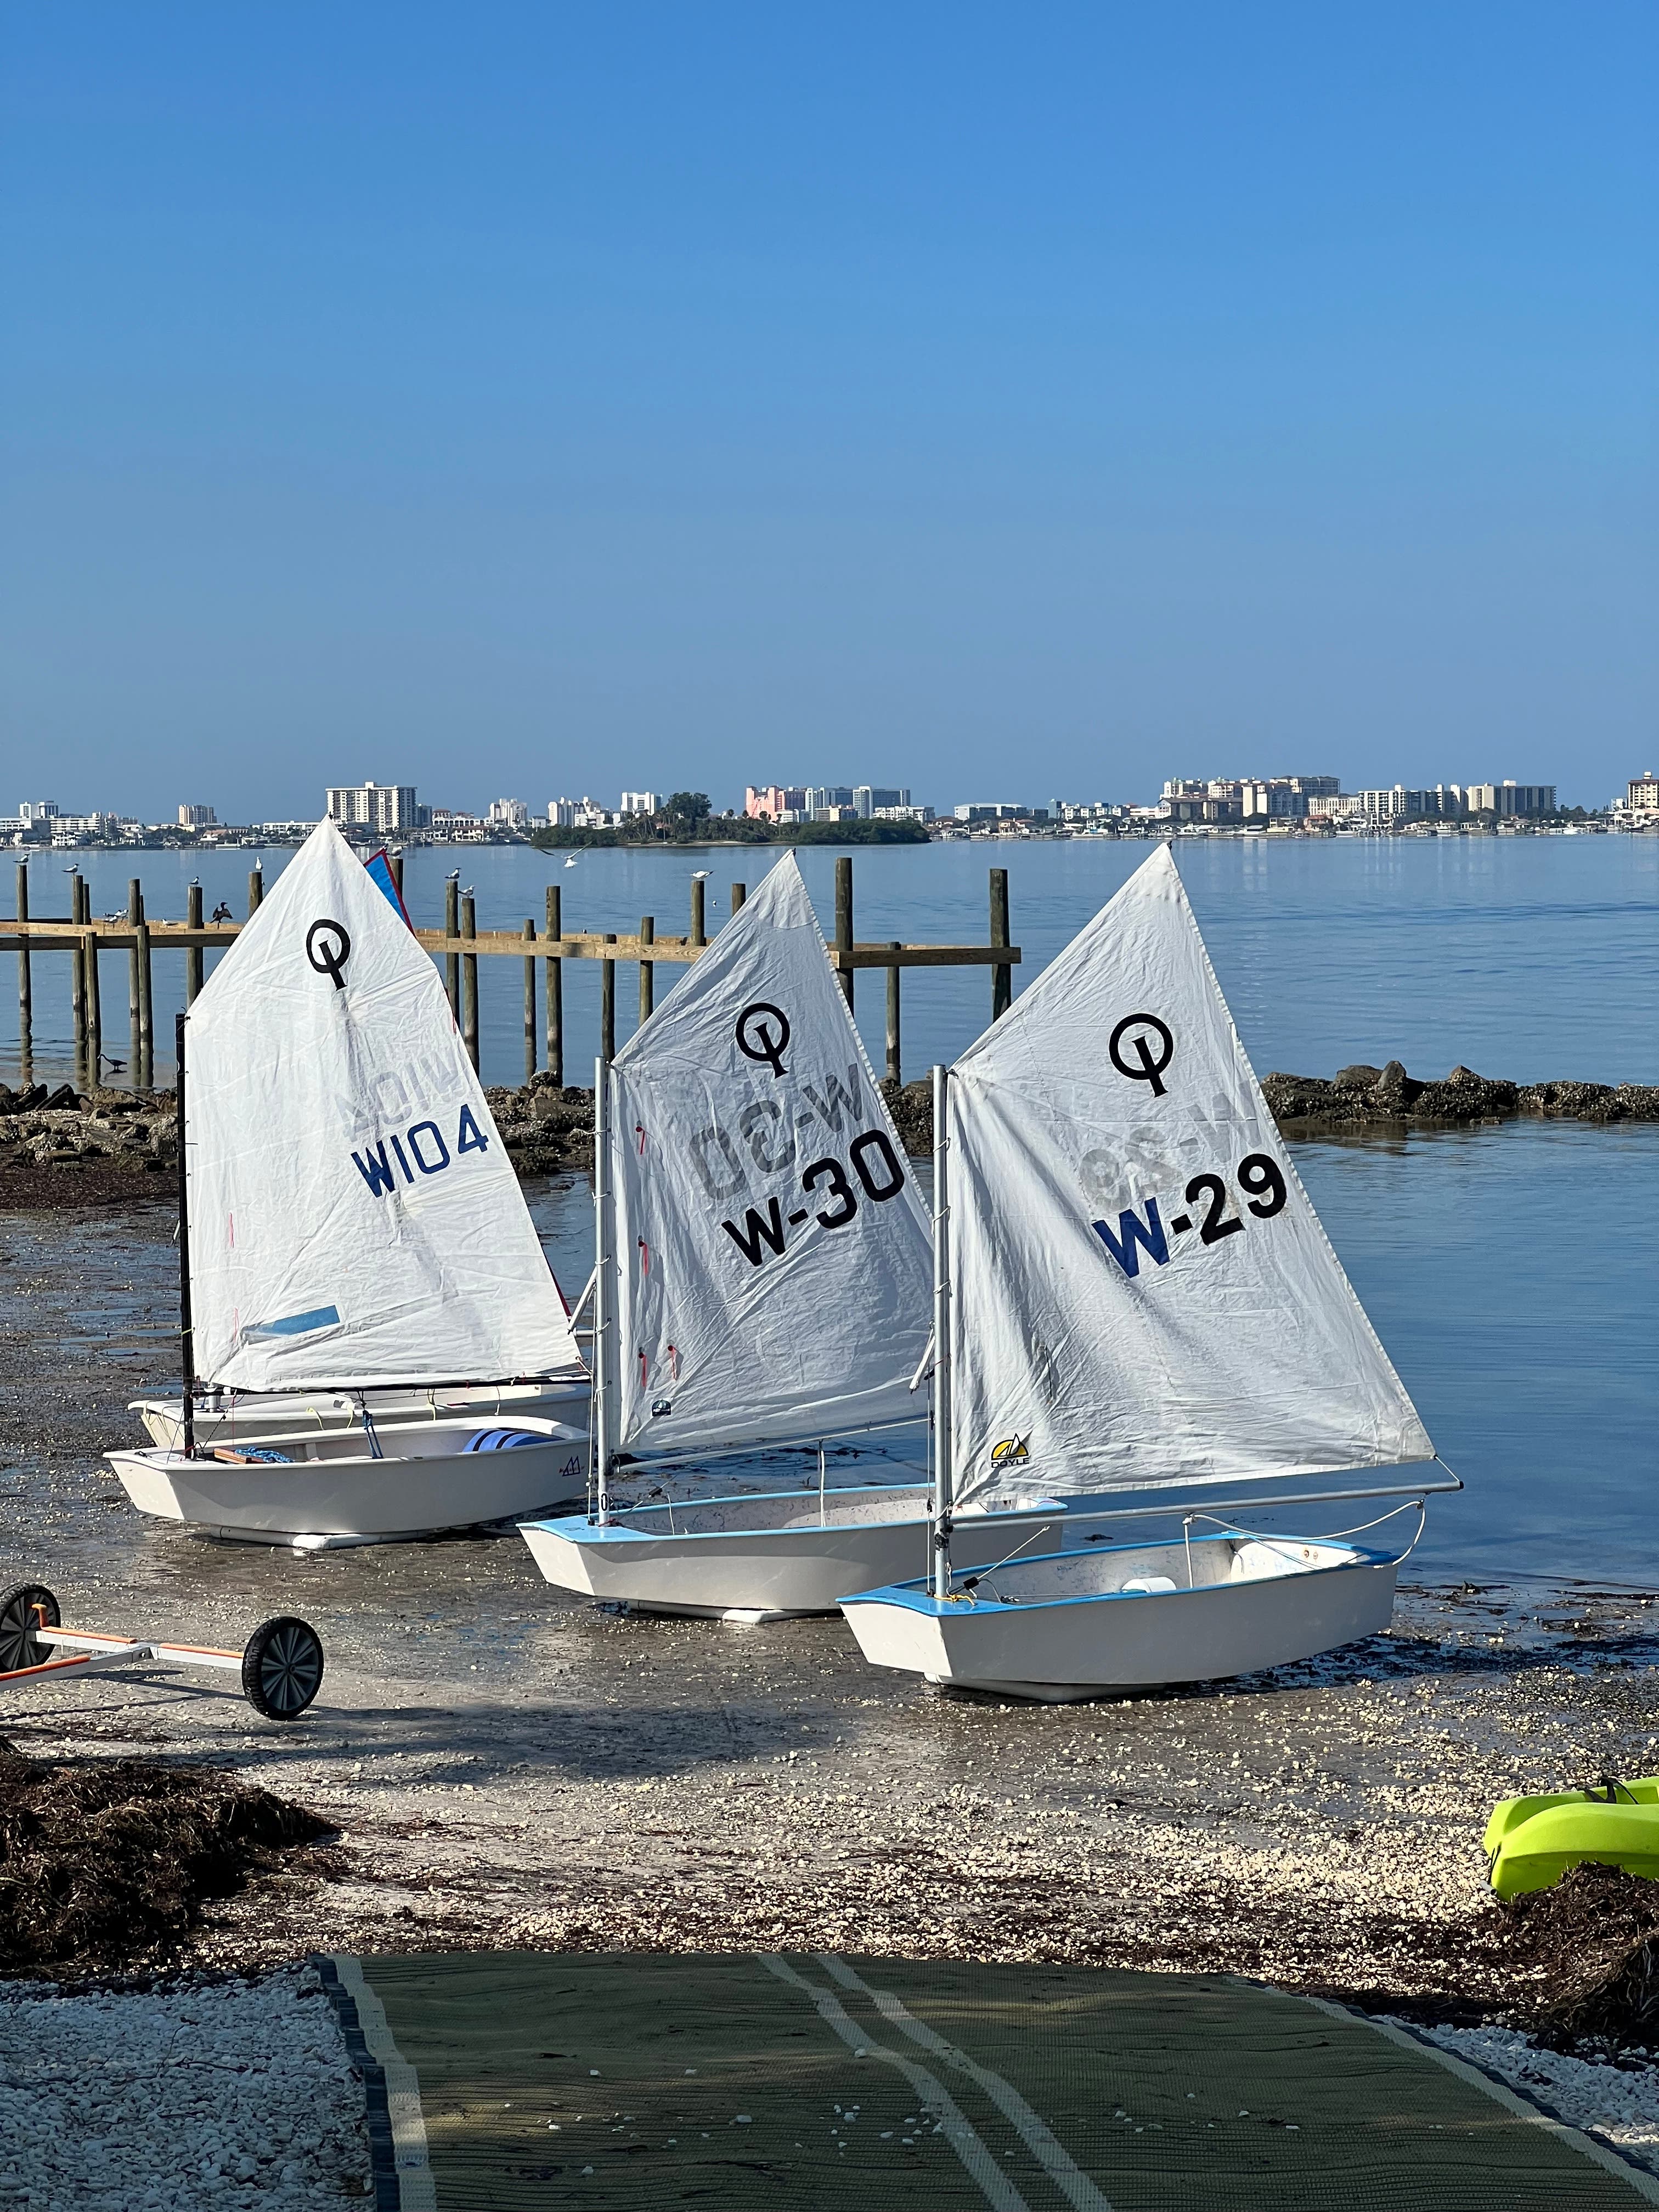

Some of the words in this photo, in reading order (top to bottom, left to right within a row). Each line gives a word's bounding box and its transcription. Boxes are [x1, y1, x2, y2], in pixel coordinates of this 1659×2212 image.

[351, 1104, 488, 1198] W104
[722, 1130, 904, 1266] W-30
[1092, 1154, 1286, 1278] W-29
[991, 1458, 1029, 1468] DOYLE
